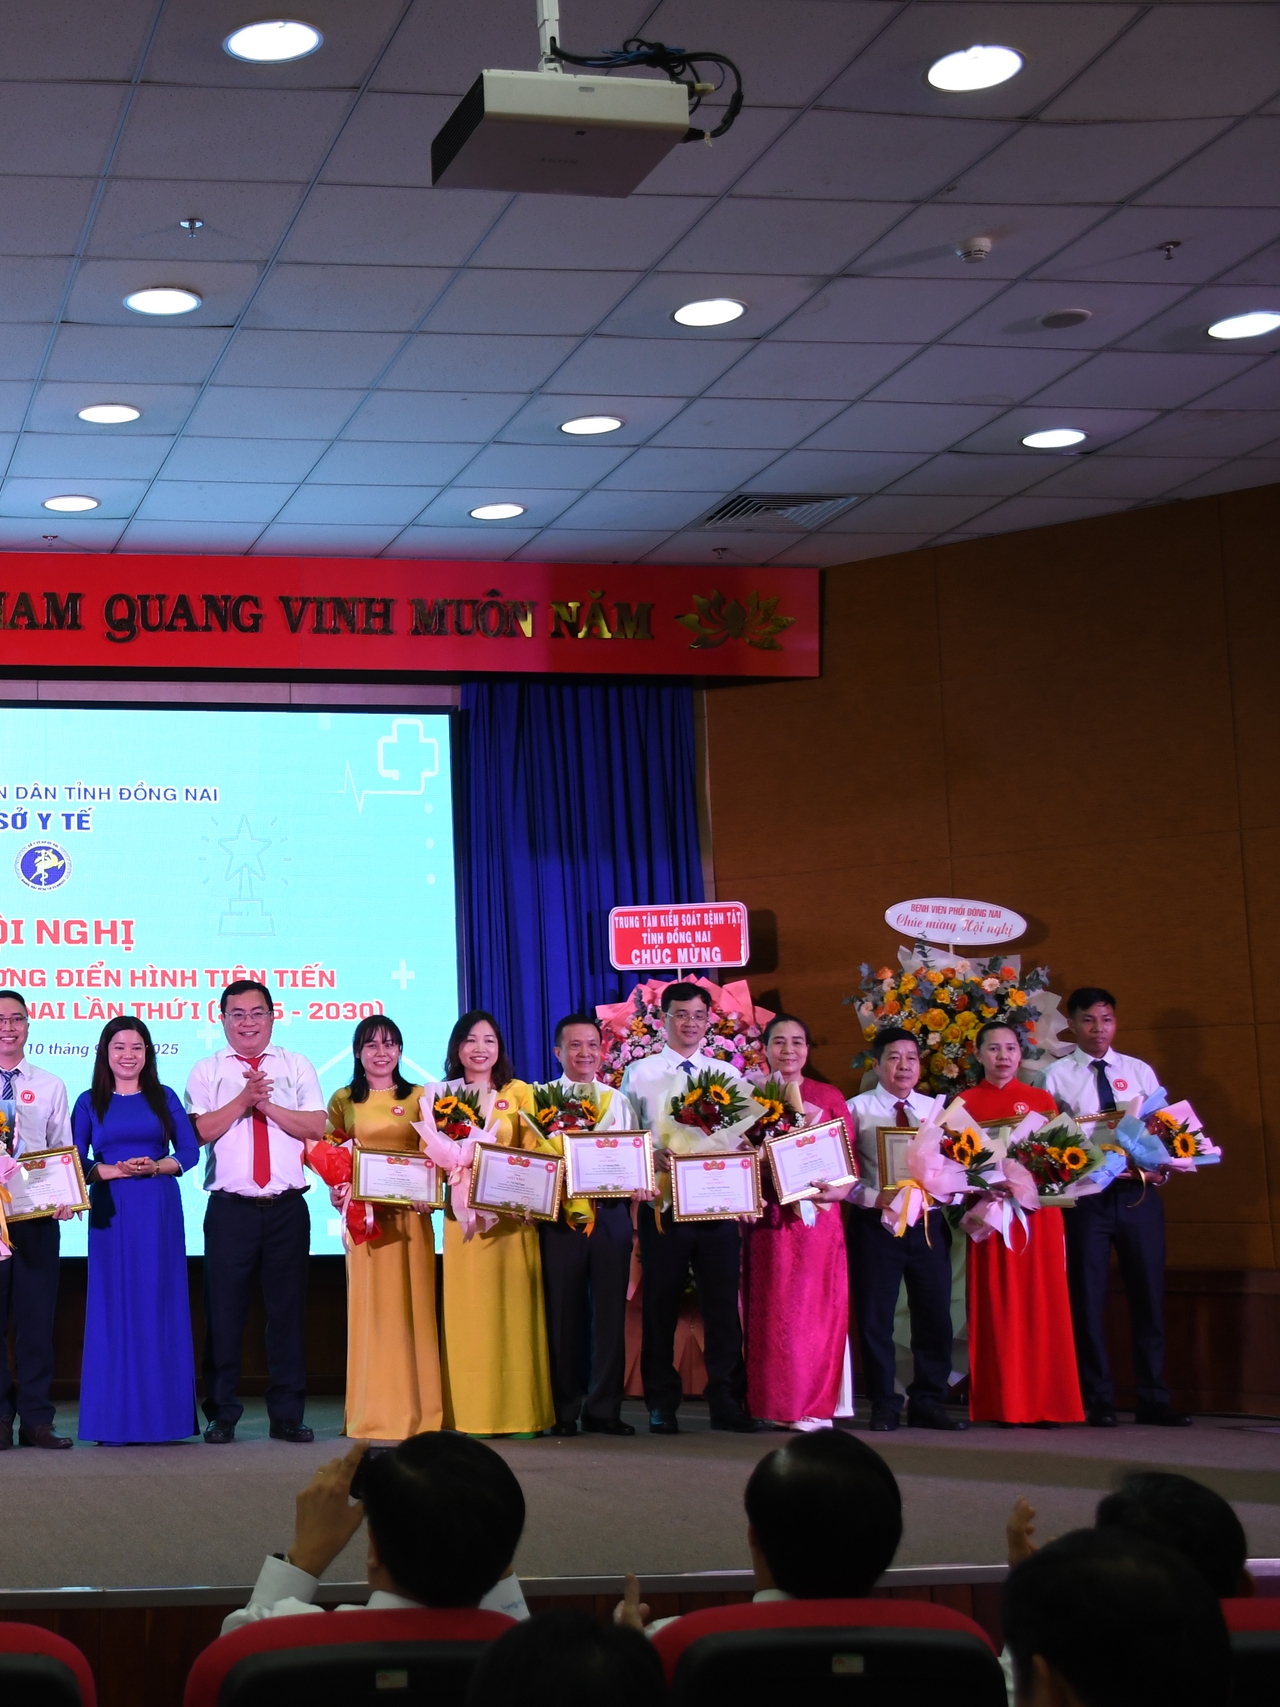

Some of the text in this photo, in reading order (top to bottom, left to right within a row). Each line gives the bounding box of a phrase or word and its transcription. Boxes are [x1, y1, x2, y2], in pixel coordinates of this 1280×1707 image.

[104, 593, 265, 643] QUANG
[278, 595, 396, 636] VINH
[409, 588, 536, 639] MUÔN
[550, 588, 654, 640] NĂM
[16, 783, 57, 800] DÂN
[64, 781, 111, 801] TỈNH
[119, 781, 177, 802] ĐỒNG
[185, 787, 218, 802] NAI
[37, 812, 53, 830] Y
[61, 807, 95, 831] TẾ
[614, 916, 640, 929] TRUNG
[642, 912, 657, 928] TÂM
[682, 911, 701, 926] SOÁT
[704, 910, 724, 928] BỆNH
[727, 909, 741, 927] TẬT
[989, 910, 1002, 919] NAI
[35, 919, 134, 951] NGHỊ
[642, 927, 711, 944] TỈNH ĐỒNG NAI
[896, 914, 923, 928] Chúc
[986, 922, 1014, 938] nghị
[631, 943, 722, 964] CHÚC MỪNG
[55, 961, 121, 988] ĐIỂN
[130, 963, 197, 988] HÌNH
[204, 965, 266, 988] TIÊN
[273, 963, 336, 988] TIẾN
[72, 995, 124, 1020] LẦN
[131, 998, 188, 1020] THỨ
[191, 1002, 200, 1020] I
[308, 1000, 383, 1020] 2030)
[28, 1043, 45, 1055] 10
[48, 1042, 89, 1058] tháng
[153, 1043, 179, 1055] 025
